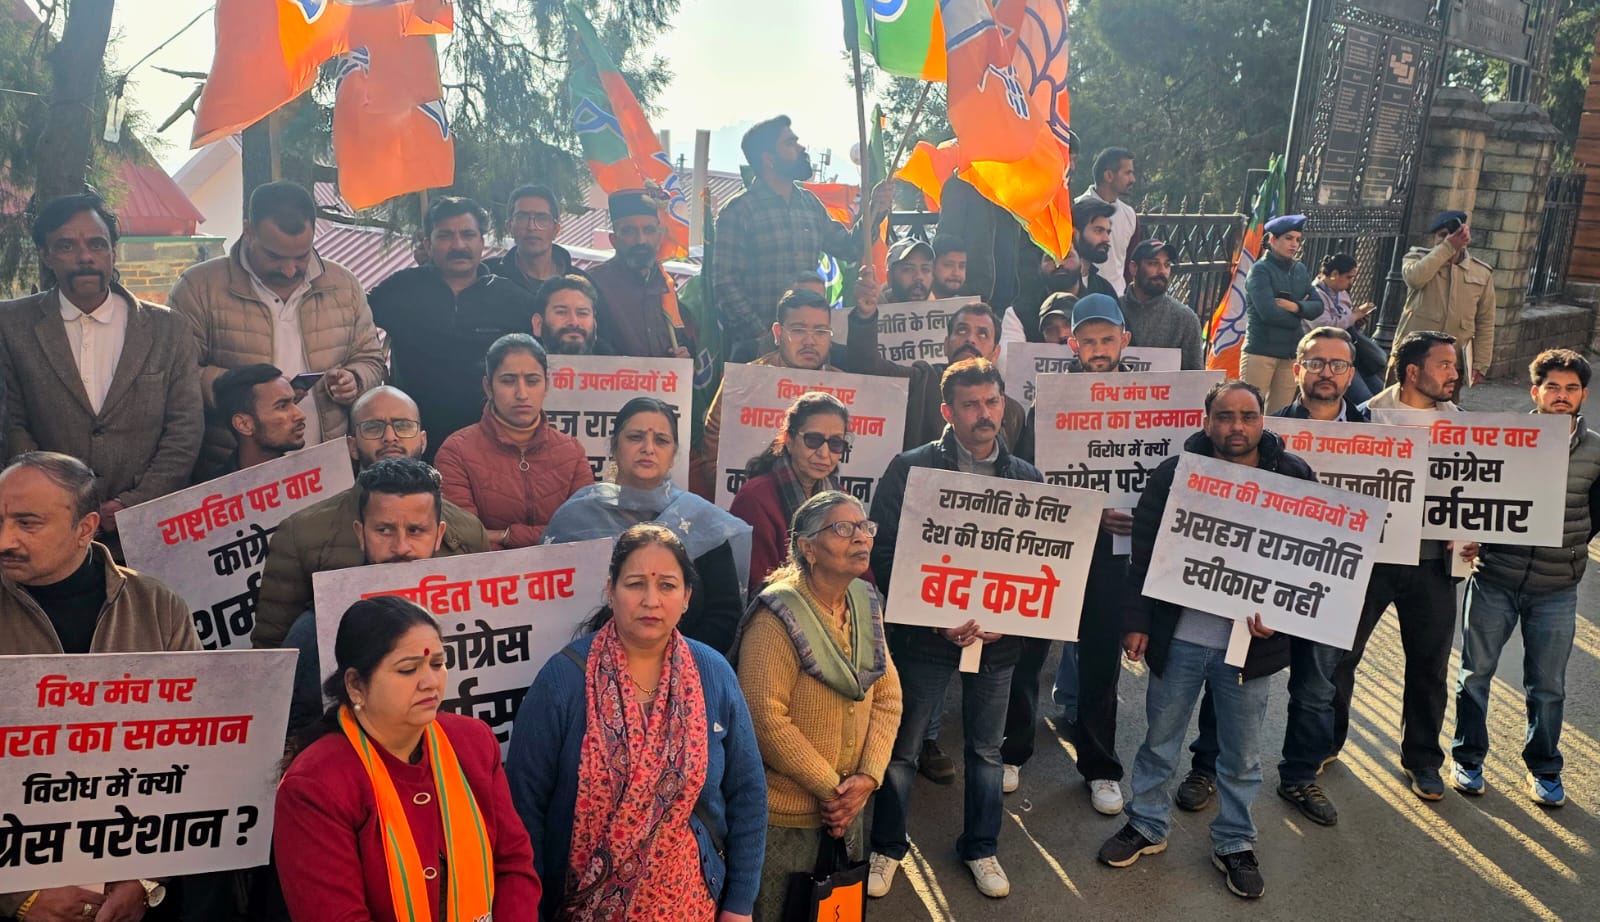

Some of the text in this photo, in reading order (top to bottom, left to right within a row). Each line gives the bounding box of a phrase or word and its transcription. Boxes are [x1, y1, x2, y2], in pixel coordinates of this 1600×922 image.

[910, 312, 924, 331] के
[889, 341, 917, 361] छवि
[552, 368, 678, 392] की उपलब्धियों से
[1090, 382, 1171, 403] विश्व मंच पर
[1055, 409, 1204, 431] भारत का सम्मान
[1470, 427, 1500, 446] पर
[1502, 428, 1540, 448] वार
[1087, 438, 1172, 459] विरोध में क्यों
[1291, 431, 1314, 452] की
[1315, 434, 1397, 457] उपलब्धियों
[1397, 437, 1414, 459] से
[1428, 451, 1504, 483] कांग्रेस
[157, 467, 323, 545] राष्ट्रहित पर वार
[939, 488, 1072, 524] राजनीति के लिए
[1187, 472, 1233, 499] भारत
[1235, 481, 1260, 506] की
[1261, 490, 1350, 528] उपलब्धियों
[1347, 508, 1369, 533] से
[1422, 486, 1533, 533] र्मसार
[922, 518, 1075, 560] देश की छवि गिराना
[1170, 508, 1363, 580] असहज राजनीति
[477, 575, 520, 608] पर
[524, 568, 576, 602] वार
[920, 554, 1061, 619] बंद करो
[1182, 556, 1331, 619] स्वीकार नहीं
[36, 673, 197, 708] विश्व मंच पर
[66, 722, 117, 753] का
[122, 715, 253, 751] सम्मान
[22, 764, 190, 805] विरोध में क्यों
[77, 805, 229, 860] परेशान
[236, 805, 259, 846] ?
